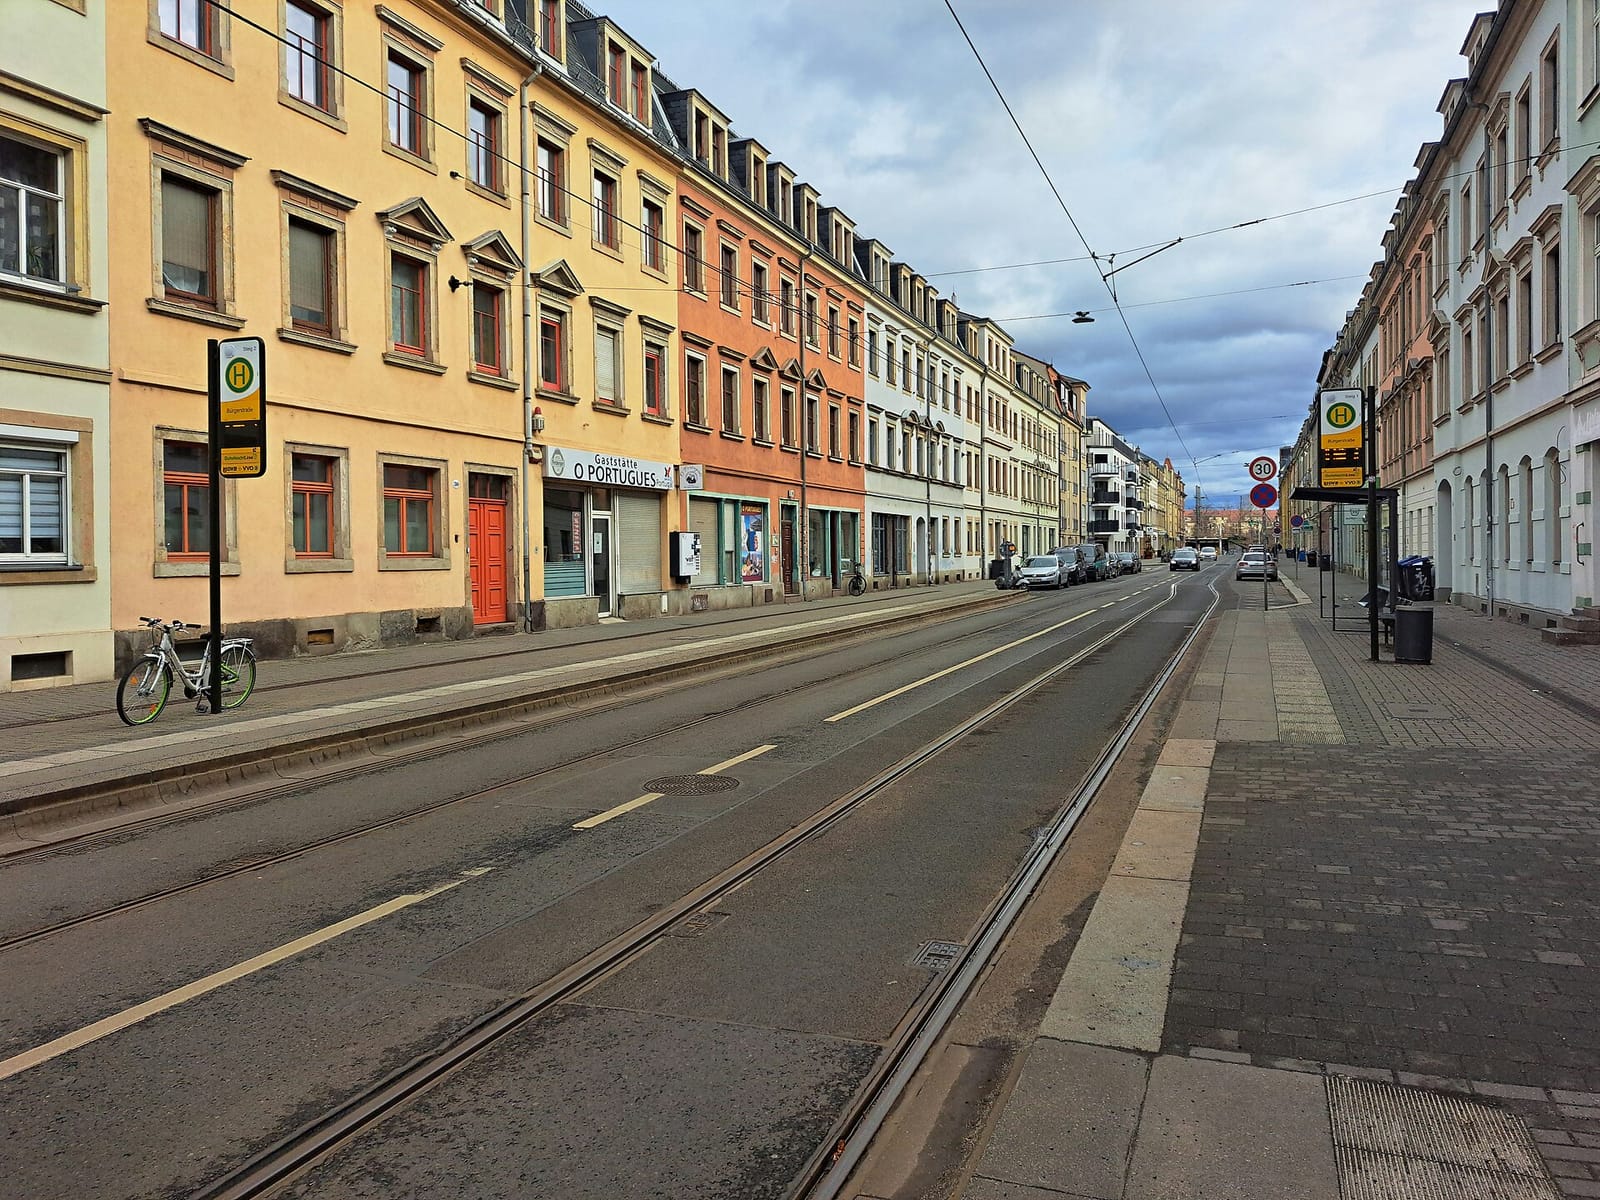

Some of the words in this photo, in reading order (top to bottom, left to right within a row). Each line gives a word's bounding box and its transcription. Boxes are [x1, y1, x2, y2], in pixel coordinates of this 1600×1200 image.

[233, 365, 245, 385] H
[1335, 408, 1347, 423] H
[595, 454, 638, 469] Gaststätte
[1255, 463, 1271, 475] 30
[574, 463, 584, 479] O
[588, 465, 656, 487] PORTUGUES
